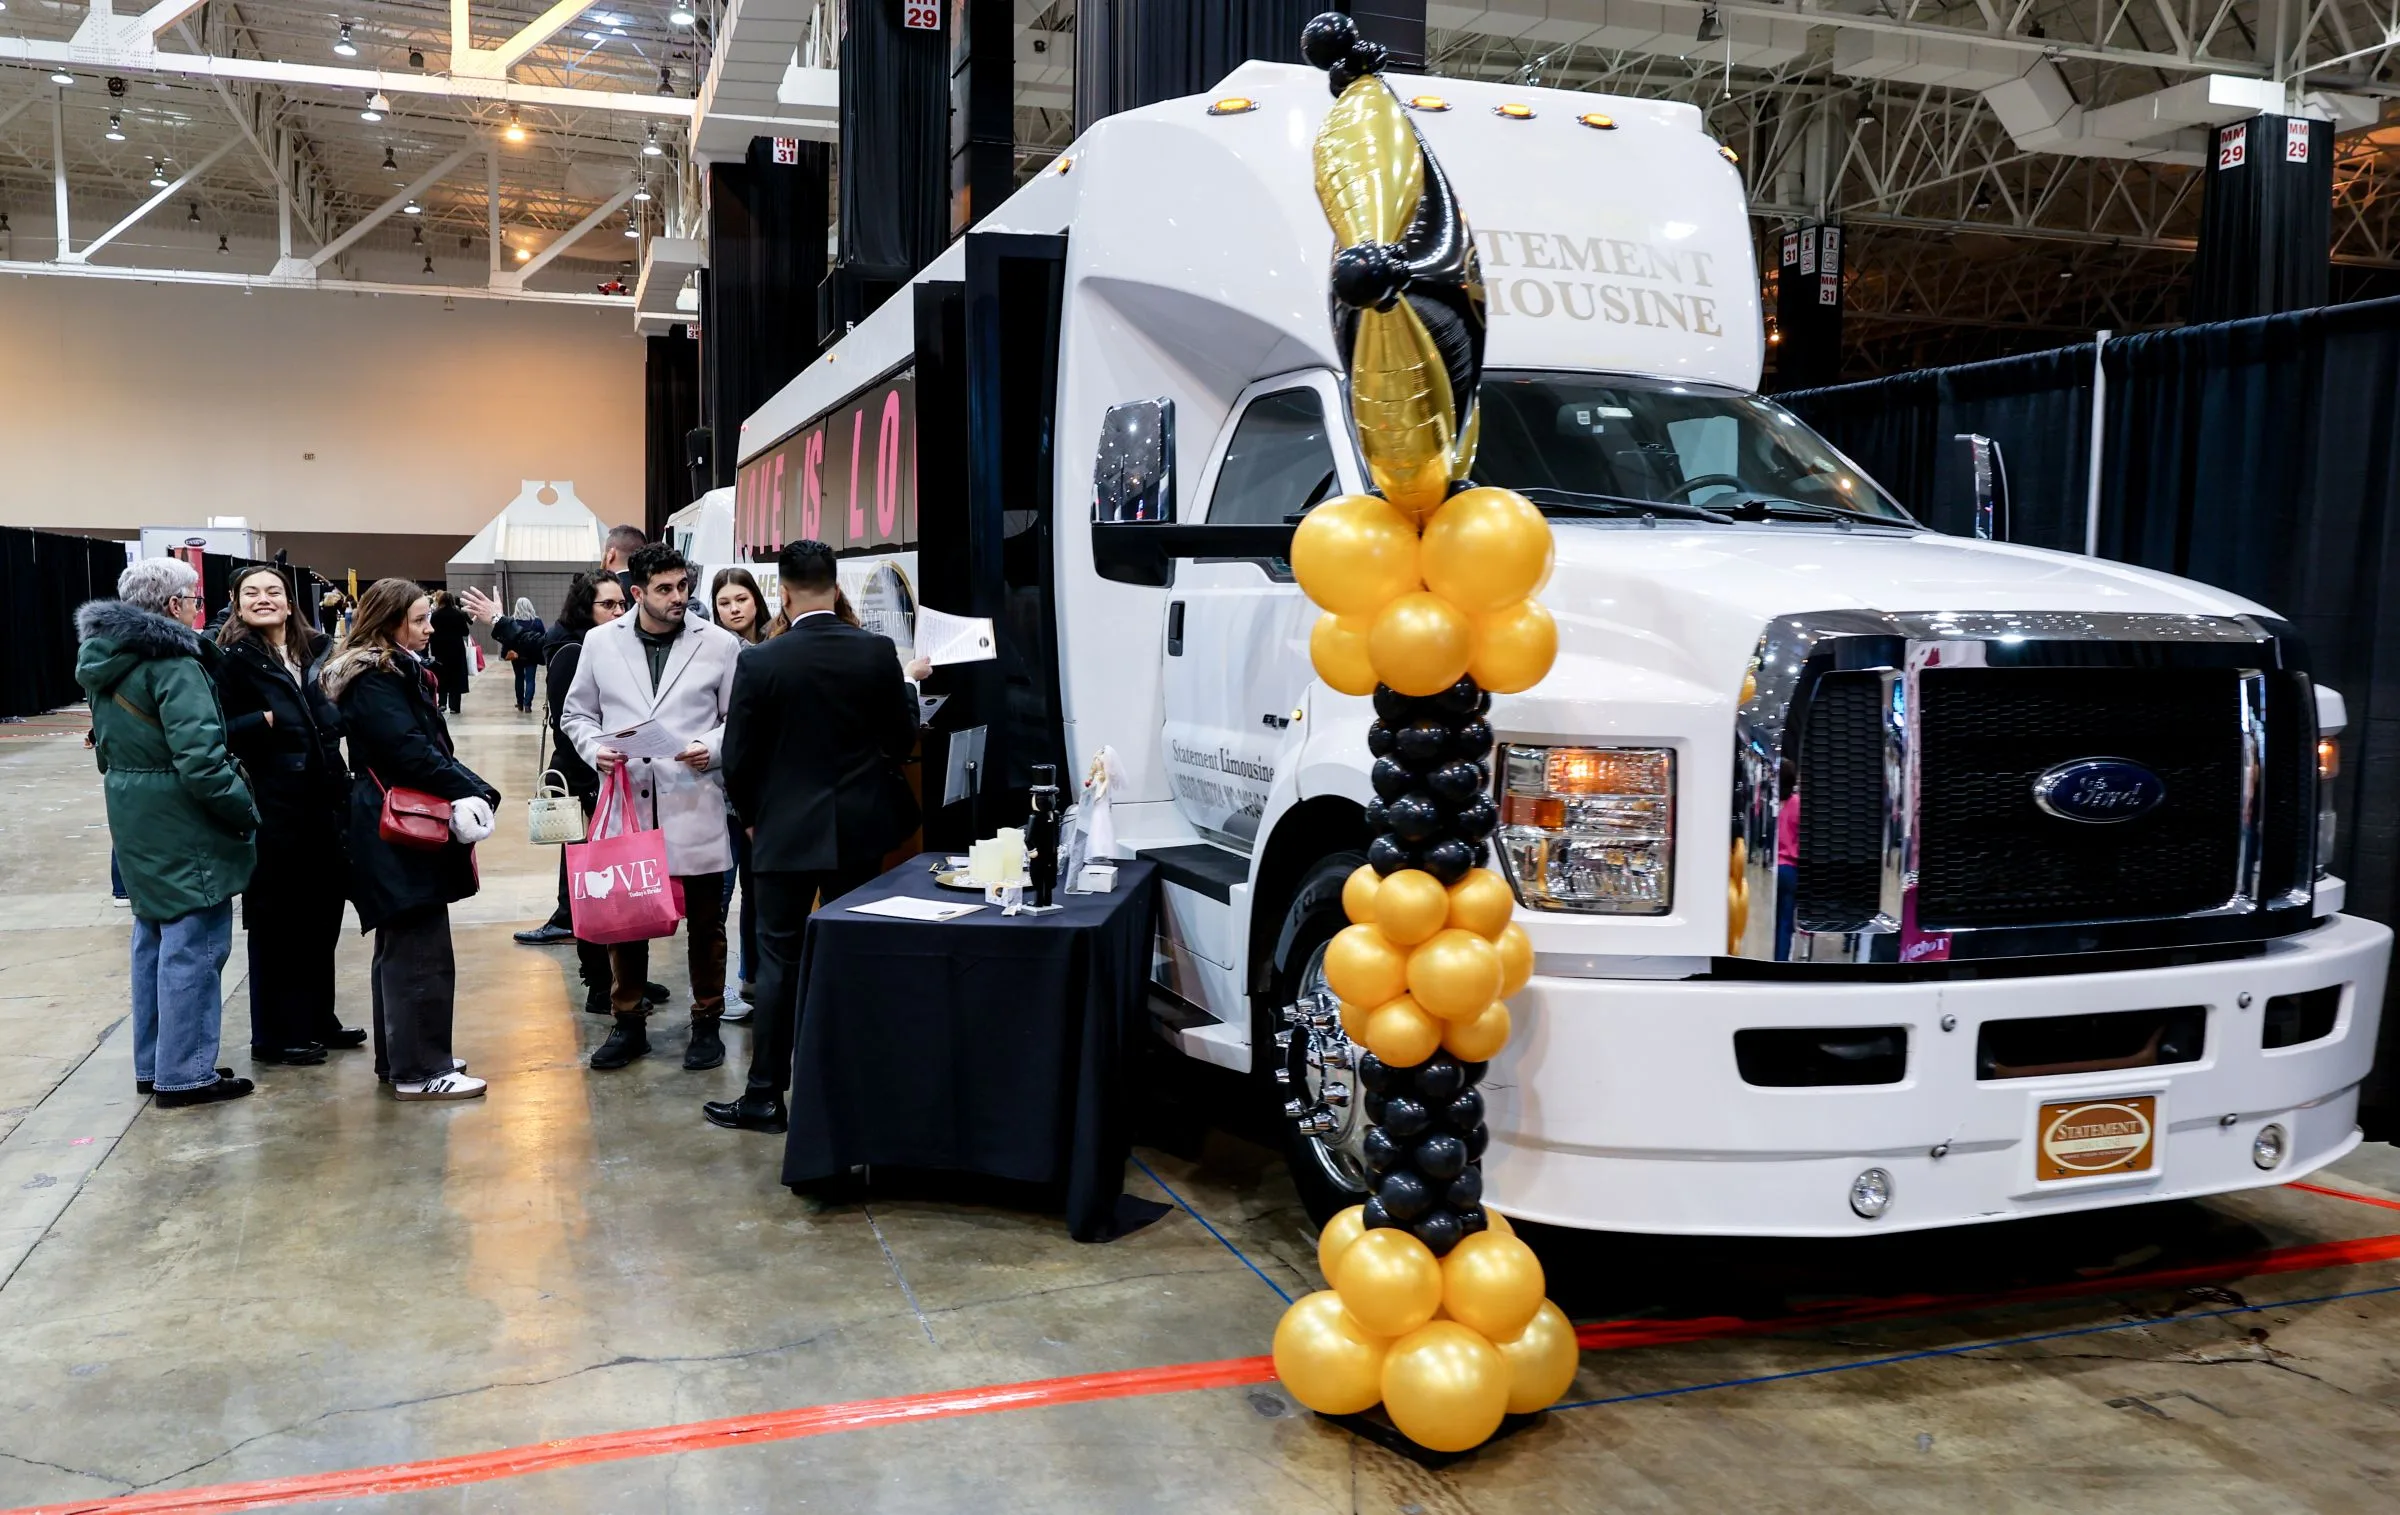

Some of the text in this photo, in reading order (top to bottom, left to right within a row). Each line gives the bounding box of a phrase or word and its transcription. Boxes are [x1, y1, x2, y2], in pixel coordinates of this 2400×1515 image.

[907, 8, 938, 28] 29
[2221, 126, 2245, 143] MM
[2288, 123, 2308, 135] MM
[776, 136, 796, 149] HH
[2288, 141, 2307, 158] 29
[777, 149, 795, 163] 31
[2221, 145, 2243, 165] 29
[1473, 229, 1713, 287] TEMENT
[1785, 249, 1796, 262] 31
[1821, 276, 1837, 286] MM
[1822, 289, 1835, 303] 31
[846, 321, 854, 334] 5
[802, 429, 823, 541] IS
[849, 389, 918, 540] LO
[1172, 739, 1275, 783] Statement Limousine
[2073, 776, 2142, 808] Ford
[2056, 1120, 2140, 1141] STATEMENT
